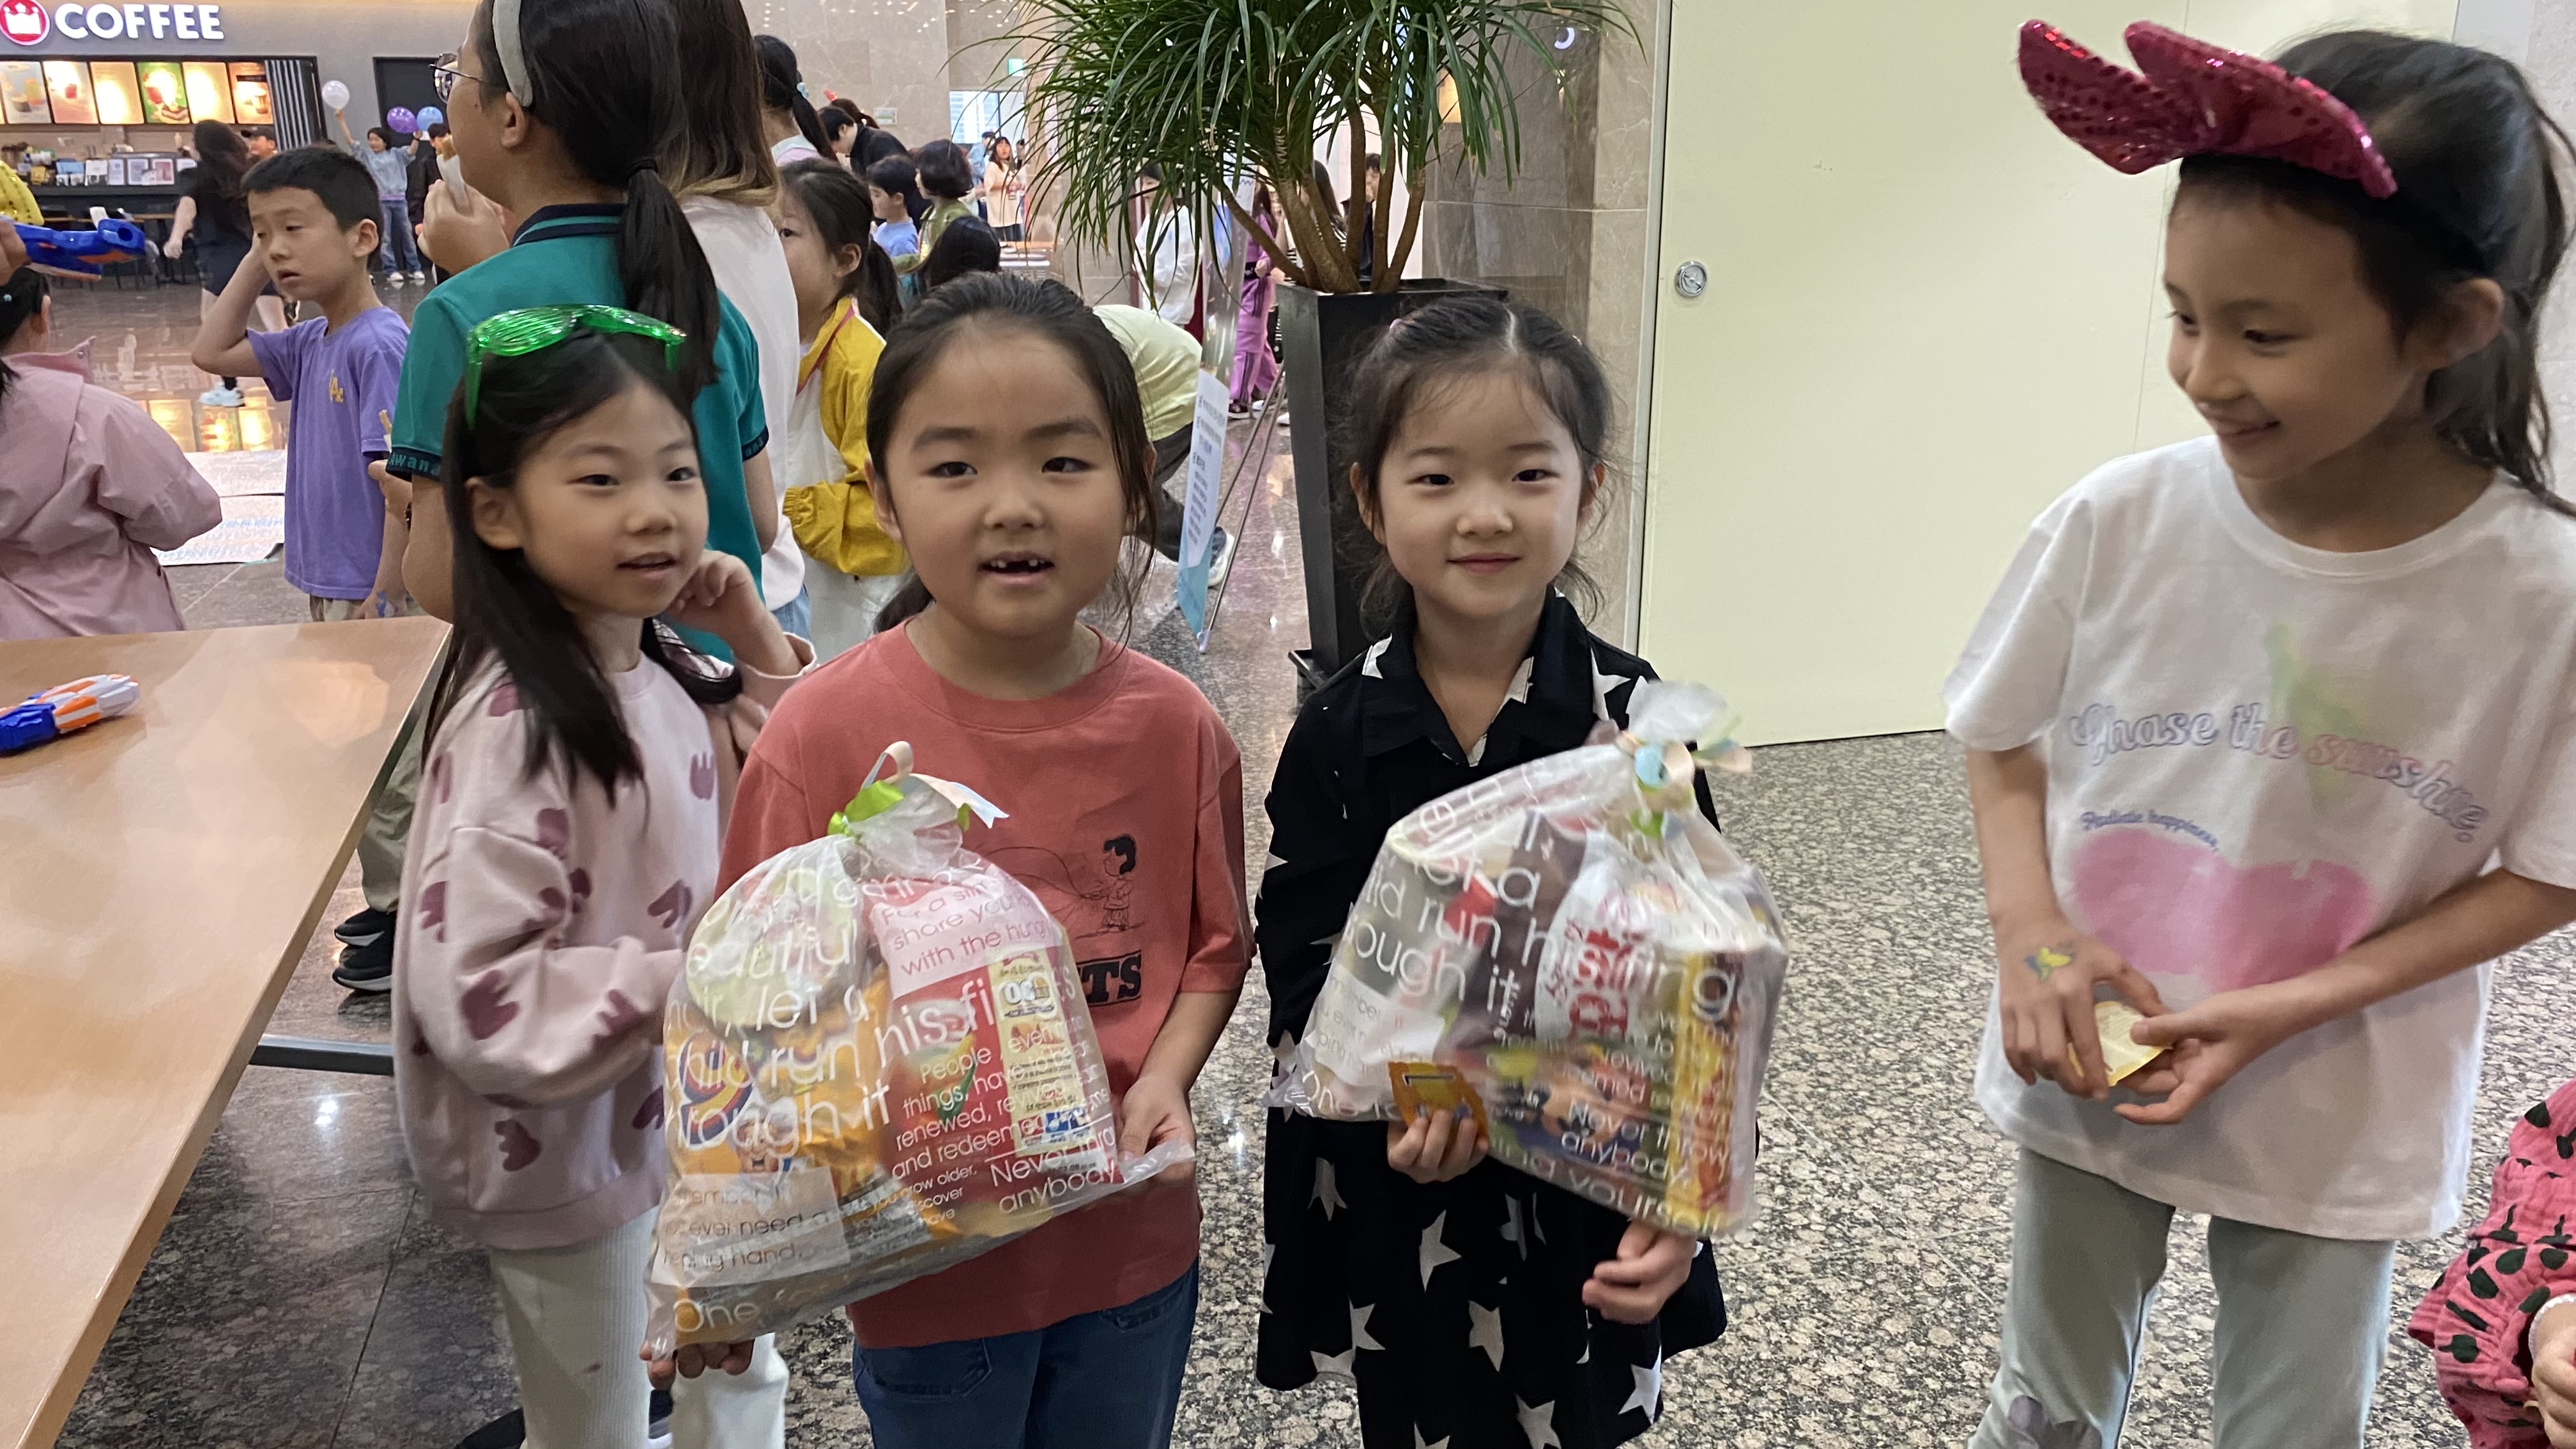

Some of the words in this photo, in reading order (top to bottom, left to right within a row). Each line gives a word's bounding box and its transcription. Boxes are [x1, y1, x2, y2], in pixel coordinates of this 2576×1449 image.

[55, 3, 224, 39] COFFEE
[2230, 702, 2300, 759] the
[929, 897, 946, 912] a
[893, 914, 964, 951] share
[900, 946, 956, 977] with
[959, 930, 1002, 957] the
[1077, 954, 1142, 1003] TS
[771, 1038, 861, 1087] run
[874, 1004, 948, 1069] his
[861, 1078, 890, 1131] it
[903, 1084, 969, 1119] things,
[896, 1101, 992, 1151] renewed,
[892, 1147, 933, 1180] and
[937, 1163, 977, 1185] older,
[991, 1148, 1069, 1186] Never
[999, 1159, 1116, 1215] anybody
[739, 1213, 803, 1237] need
[673, 1298, 760, 1333] One
